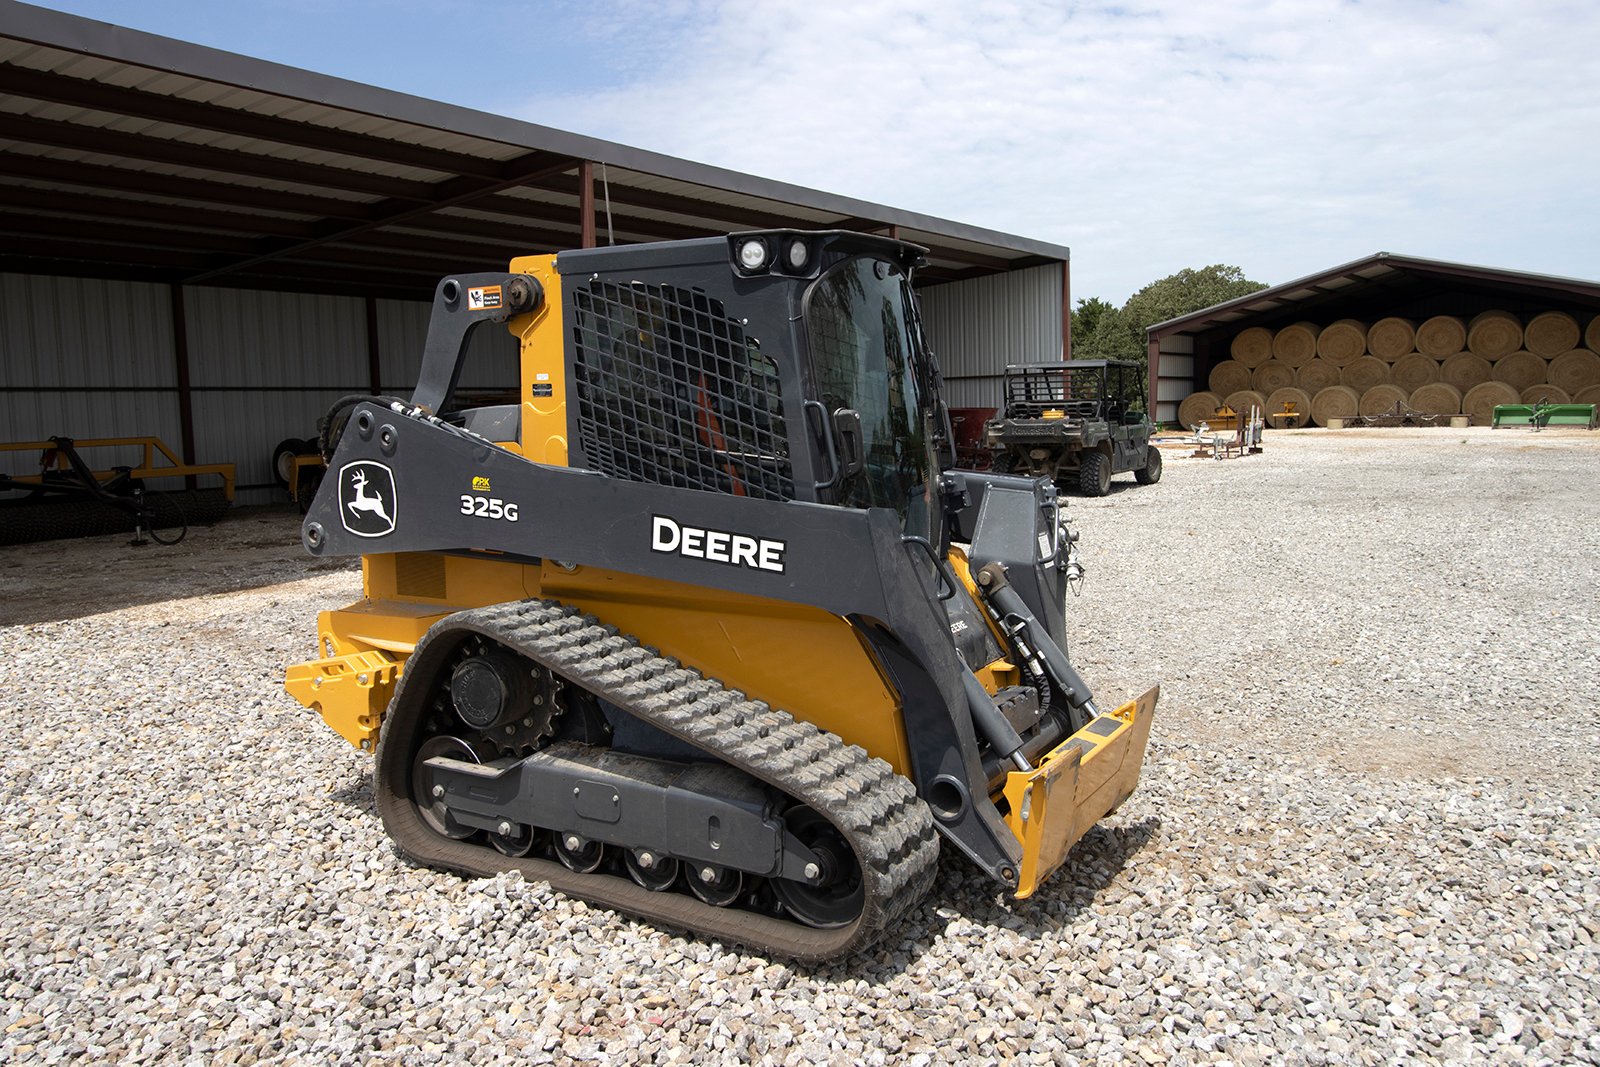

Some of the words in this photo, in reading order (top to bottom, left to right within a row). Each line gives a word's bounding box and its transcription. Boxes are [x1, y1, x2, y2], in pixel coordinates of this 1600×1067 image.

[460, 494, 518, 521] 325G
[652, 516, 785, 572] DEERE
[950, 620, 968, 634] EERE
